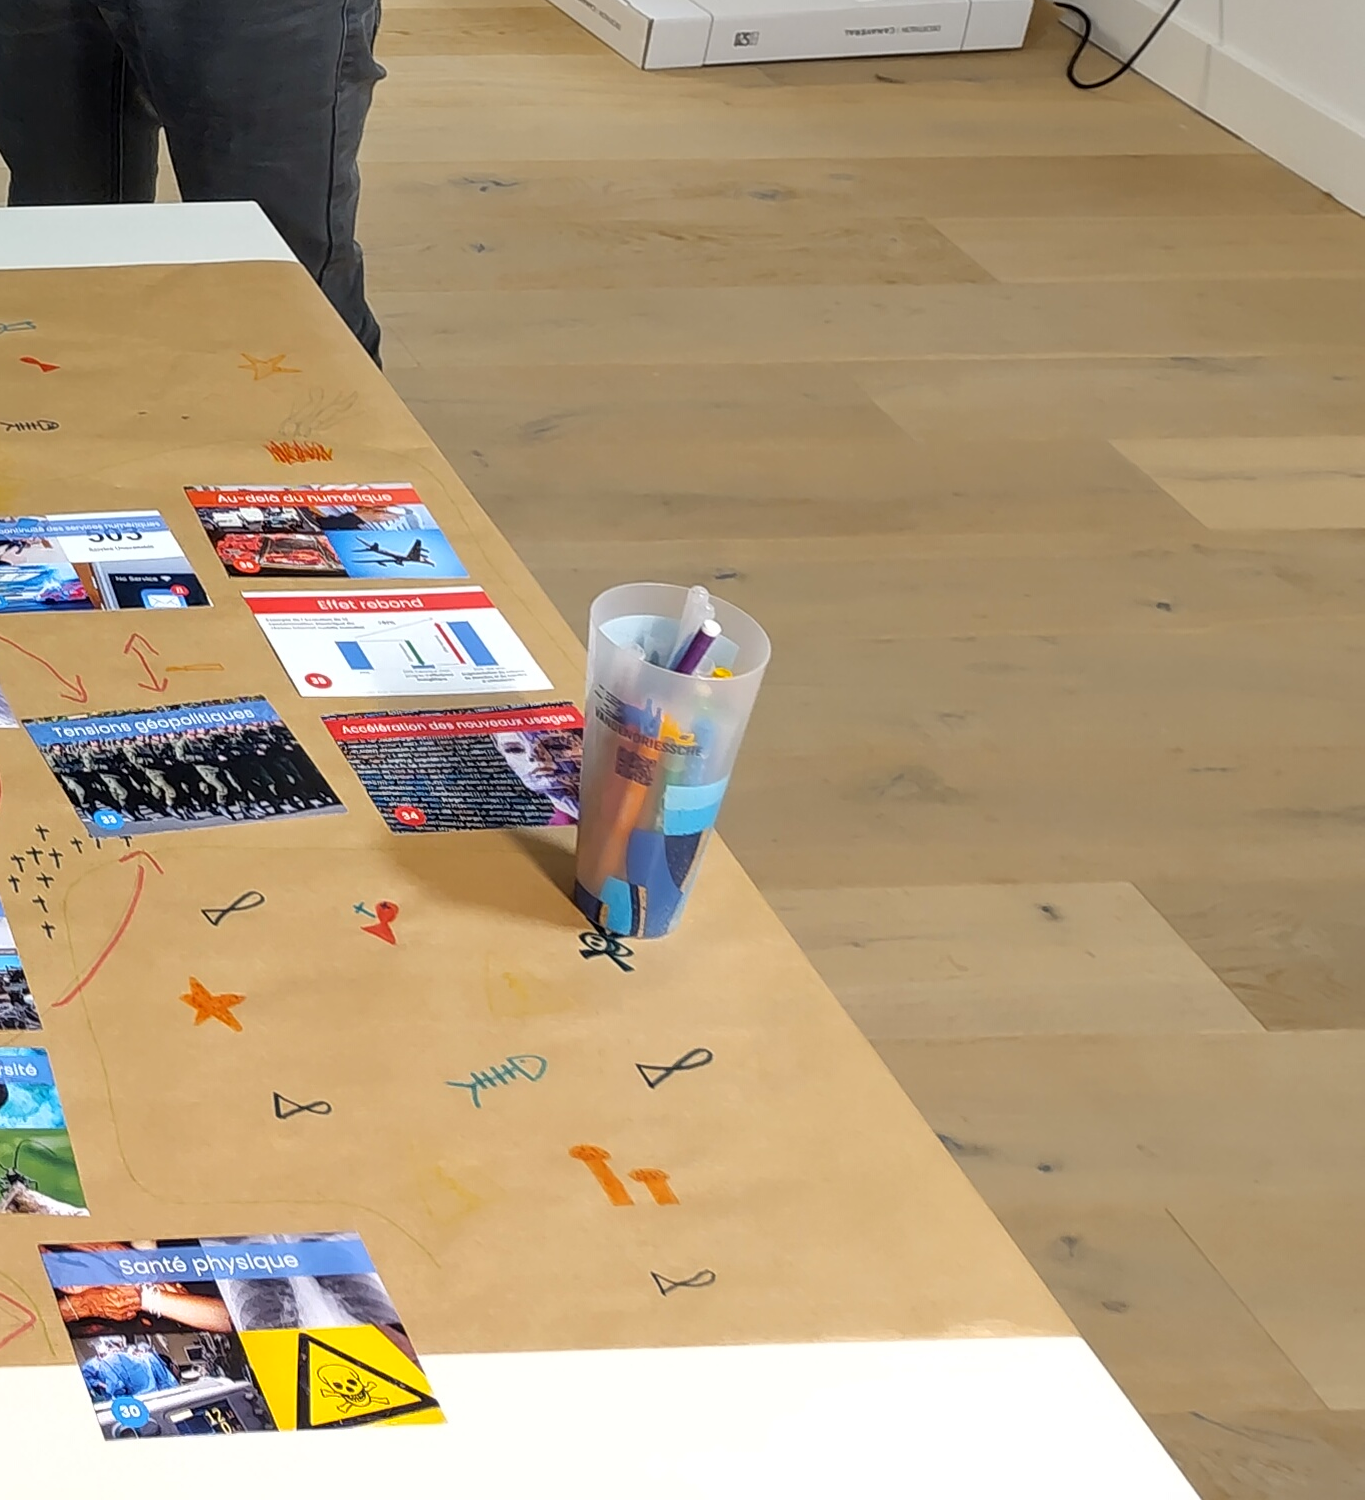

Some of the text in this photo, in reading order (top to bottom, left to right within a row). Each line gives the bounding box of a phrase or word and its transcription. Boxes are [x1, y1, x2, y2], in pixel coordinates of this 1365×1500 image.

[218, 490, 392, 504] Au-delà du numérique
[46, 524, 65, 534] des
[65, 522, 103, 533] services
[104, 519, 162, 533] numériques
[316, 597, 424, 611] Effet rebond
[51, 708, 255, 739] Tensions géopolitiques
[342, 713, 575, 735] Accélération des nouveaux usages
[401, 811, 419, 822] 34
[118, 1251, 300, 1282] Santé physique
[119, 1403, 142, 1420] 30
